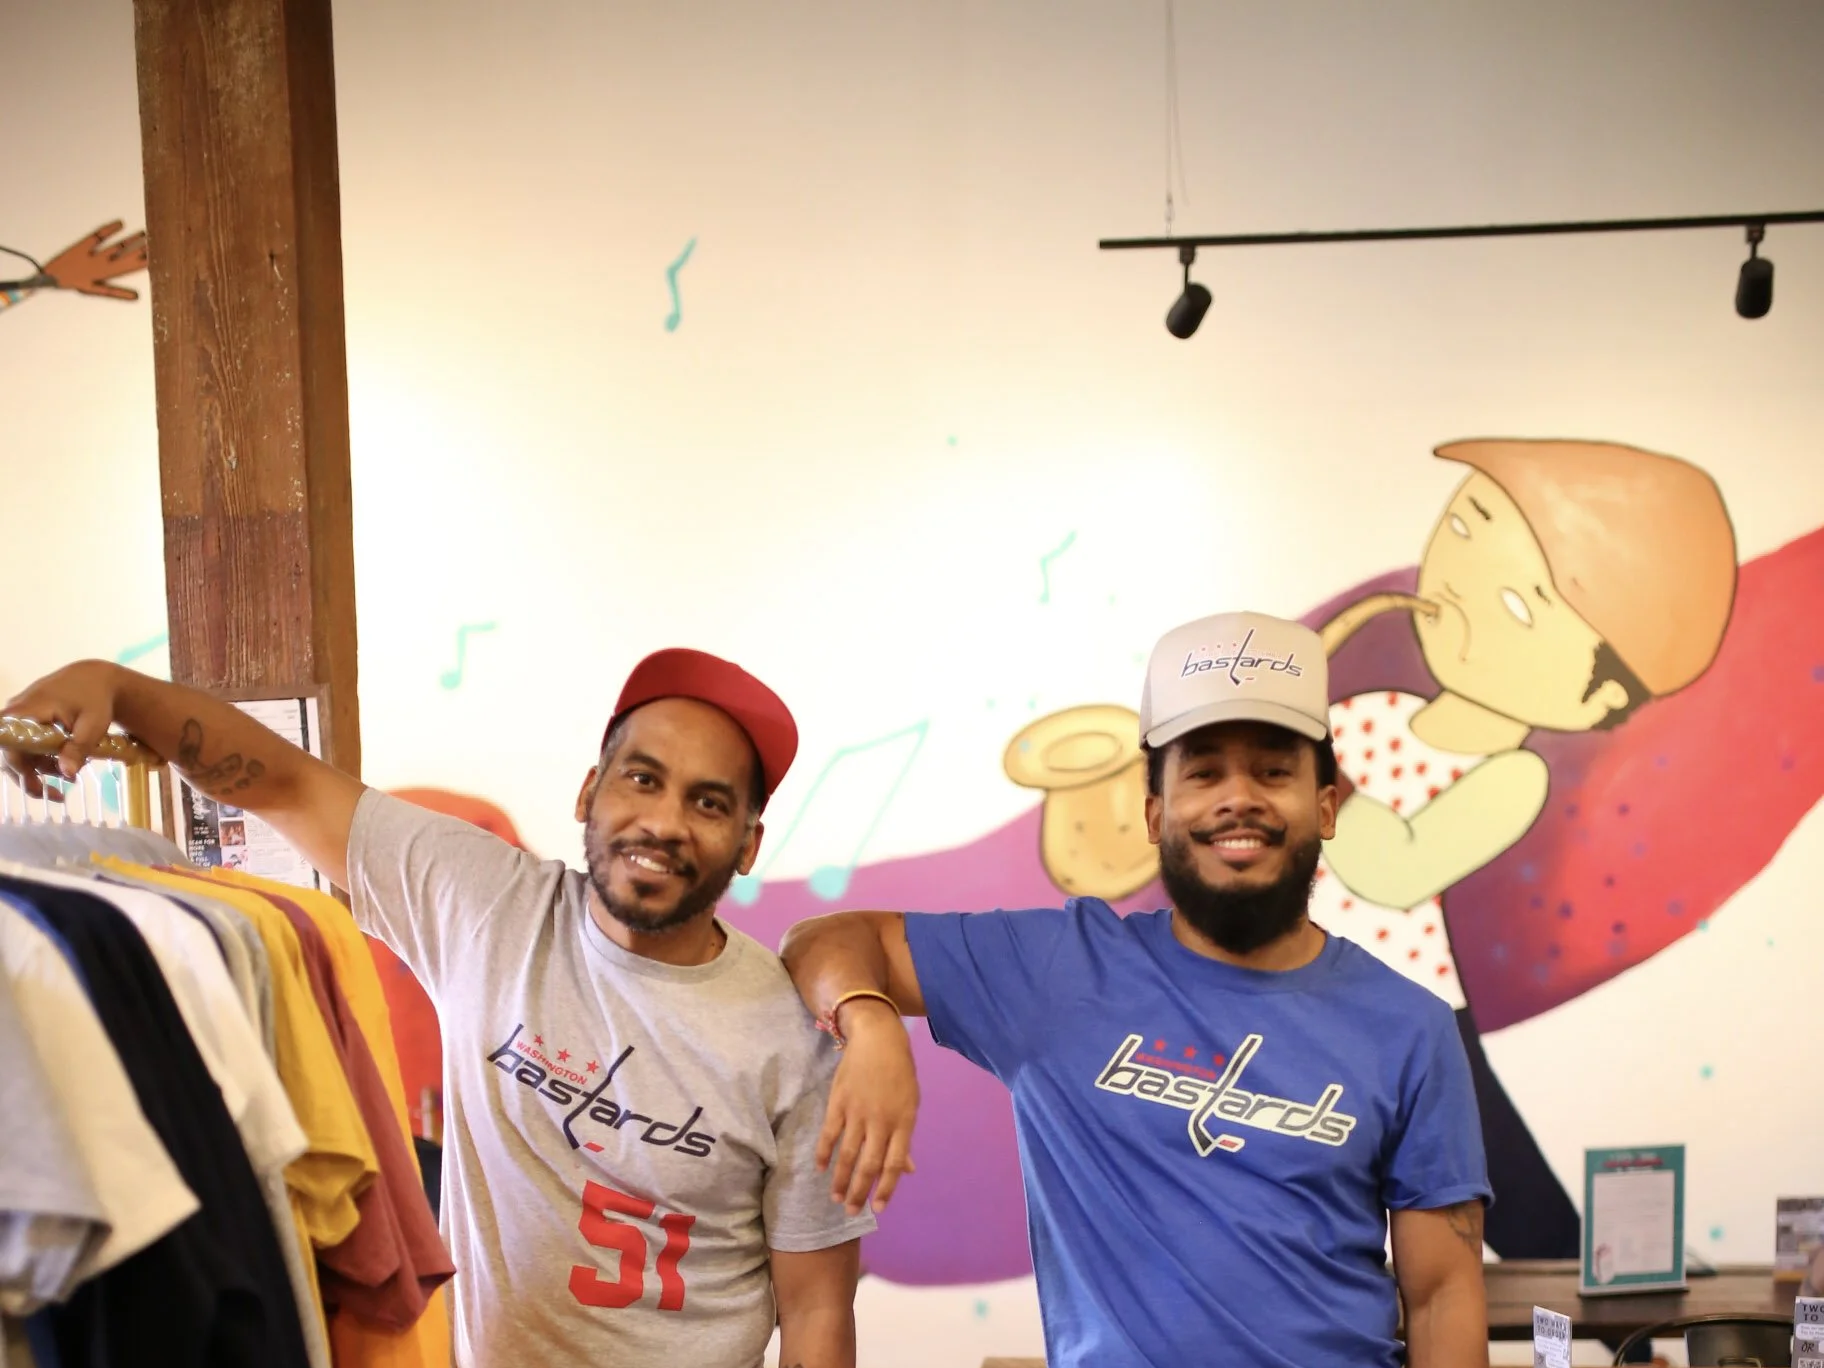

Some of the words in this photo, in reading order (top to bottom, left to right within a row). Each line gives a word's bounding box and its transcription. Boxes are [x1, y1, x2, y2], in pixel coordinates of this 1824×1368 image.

[1181, 629, 1304, 687] bastards
[487, 1023, 717, 1158] bastards
[516, 1040, 588, 1086] WASHINGTON
[1094, 1033, 1358, 1158] bastards
[568, 1179, 697, 1312] 51
